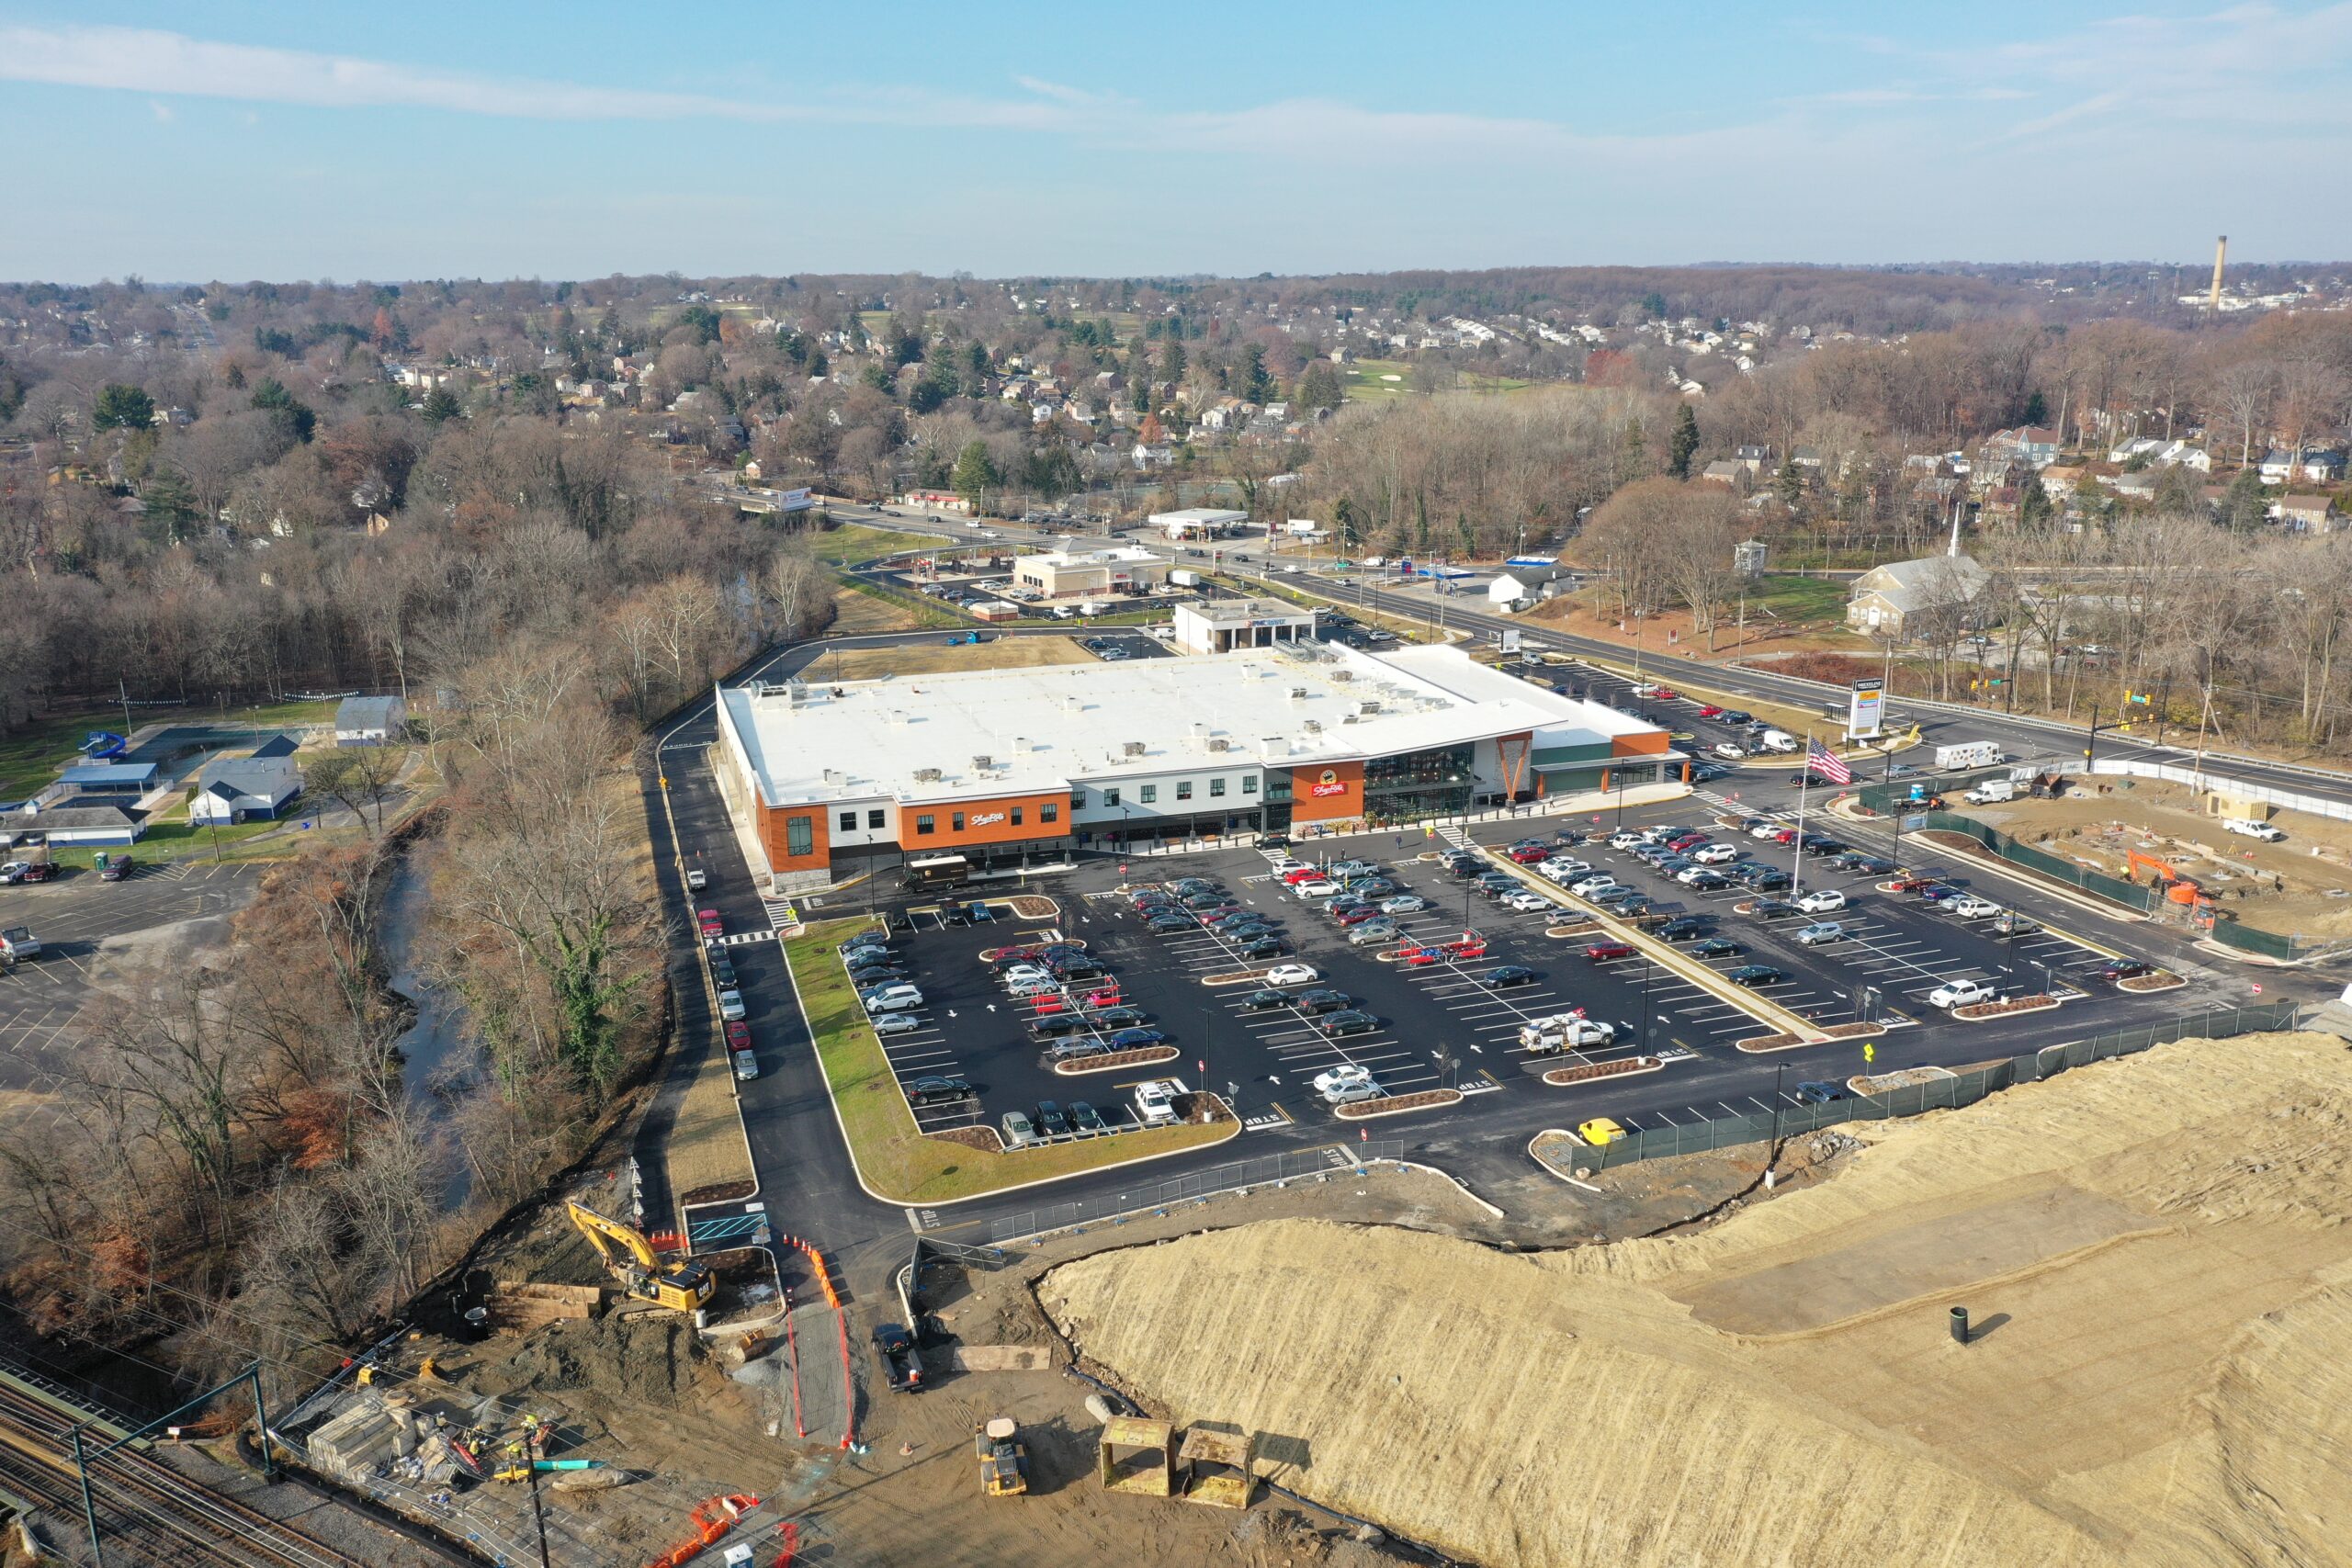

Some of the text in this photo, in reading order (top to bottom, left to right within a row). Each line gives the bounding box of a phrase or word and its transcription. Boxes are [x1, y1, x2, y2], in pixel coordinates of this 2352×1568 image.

[1313, 784, 1344, 796] ShopRite
[970, 812, 1004, 825] ShopRite
[2048, 988, 2078, 997] STOP
[1878, 1015, 1909, 1025] STOP
[1656, 1048, 1688, 1059] STOP
[1459, 1079, 1492, 1090] STOP
[1245, 1114, 1281, 1125] STOP
[1322, 1148, 1348, 1167] STOP
[921, 1210, 941, 1228] STOP
[698, 1282, 709, 1297] CAT
